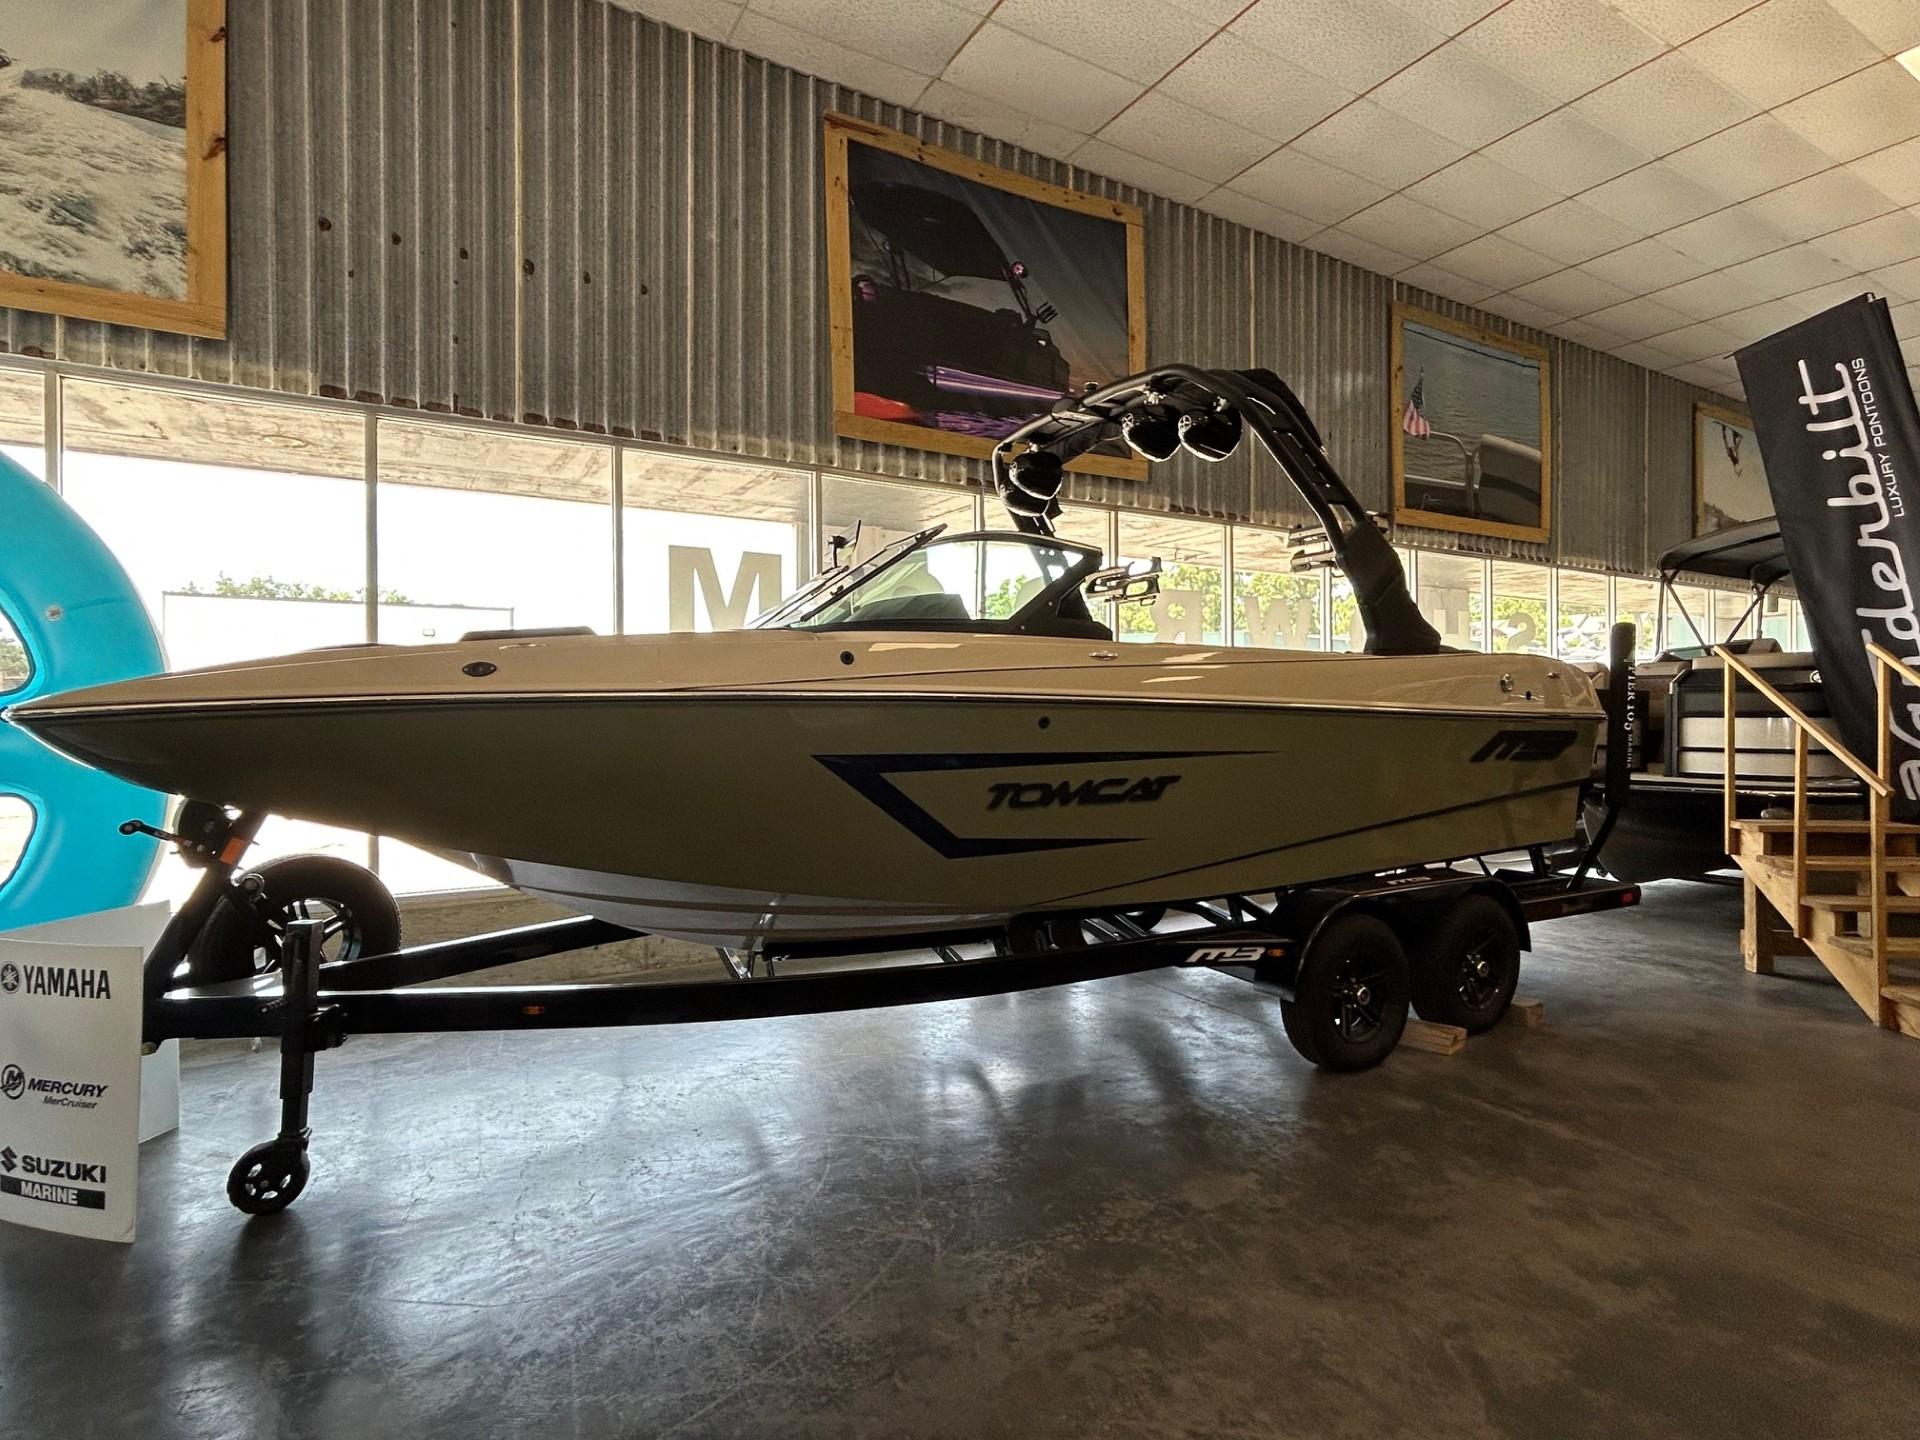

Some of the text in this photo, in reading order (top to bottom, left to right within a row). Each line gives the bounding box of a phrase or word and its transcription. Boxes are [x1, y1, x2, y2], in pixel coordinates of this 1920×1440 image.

[1851, 357, 1905, 518] LUXURY PONTOONS
[987, 775, 1182, 810] TOMCAT
[23, 965, 111, 999] YAMAHA
[27, 1078, 109, 1097] MERCURY
[42, 1095, 98, 1109] MerCruiser
[21, 1155, 106, 1183] SUZUKI
[20, 1180, 79, 1205] MARINE
